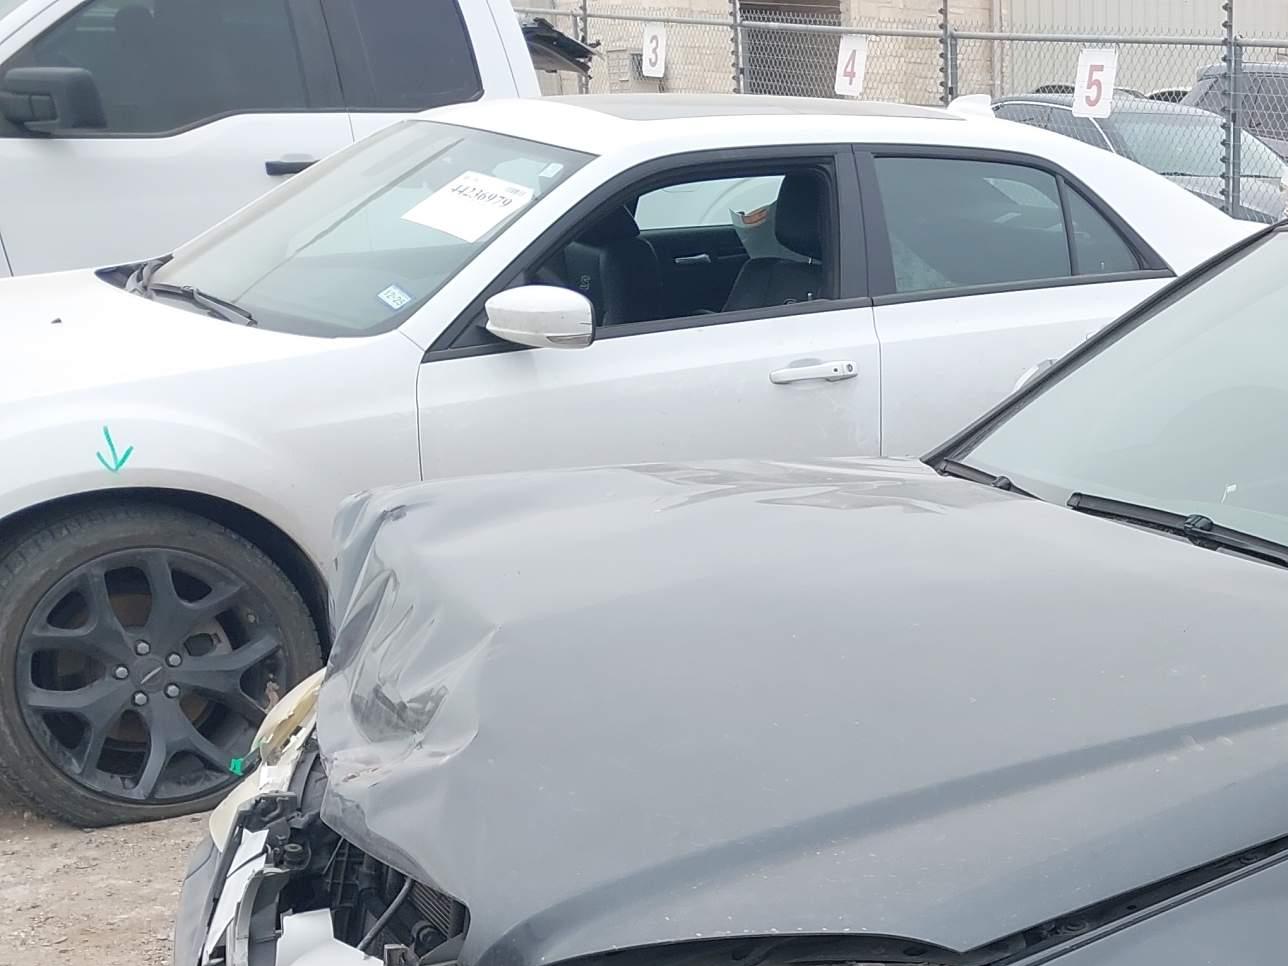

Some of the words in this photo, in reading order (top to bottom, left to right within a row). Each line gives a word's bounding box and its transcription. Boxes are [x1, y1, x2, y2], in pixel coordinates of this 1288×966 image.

[649, 35, 660, 67] 3
[843, 48, 858, 86] 4
[1085, 64, 1104, 106] 5
